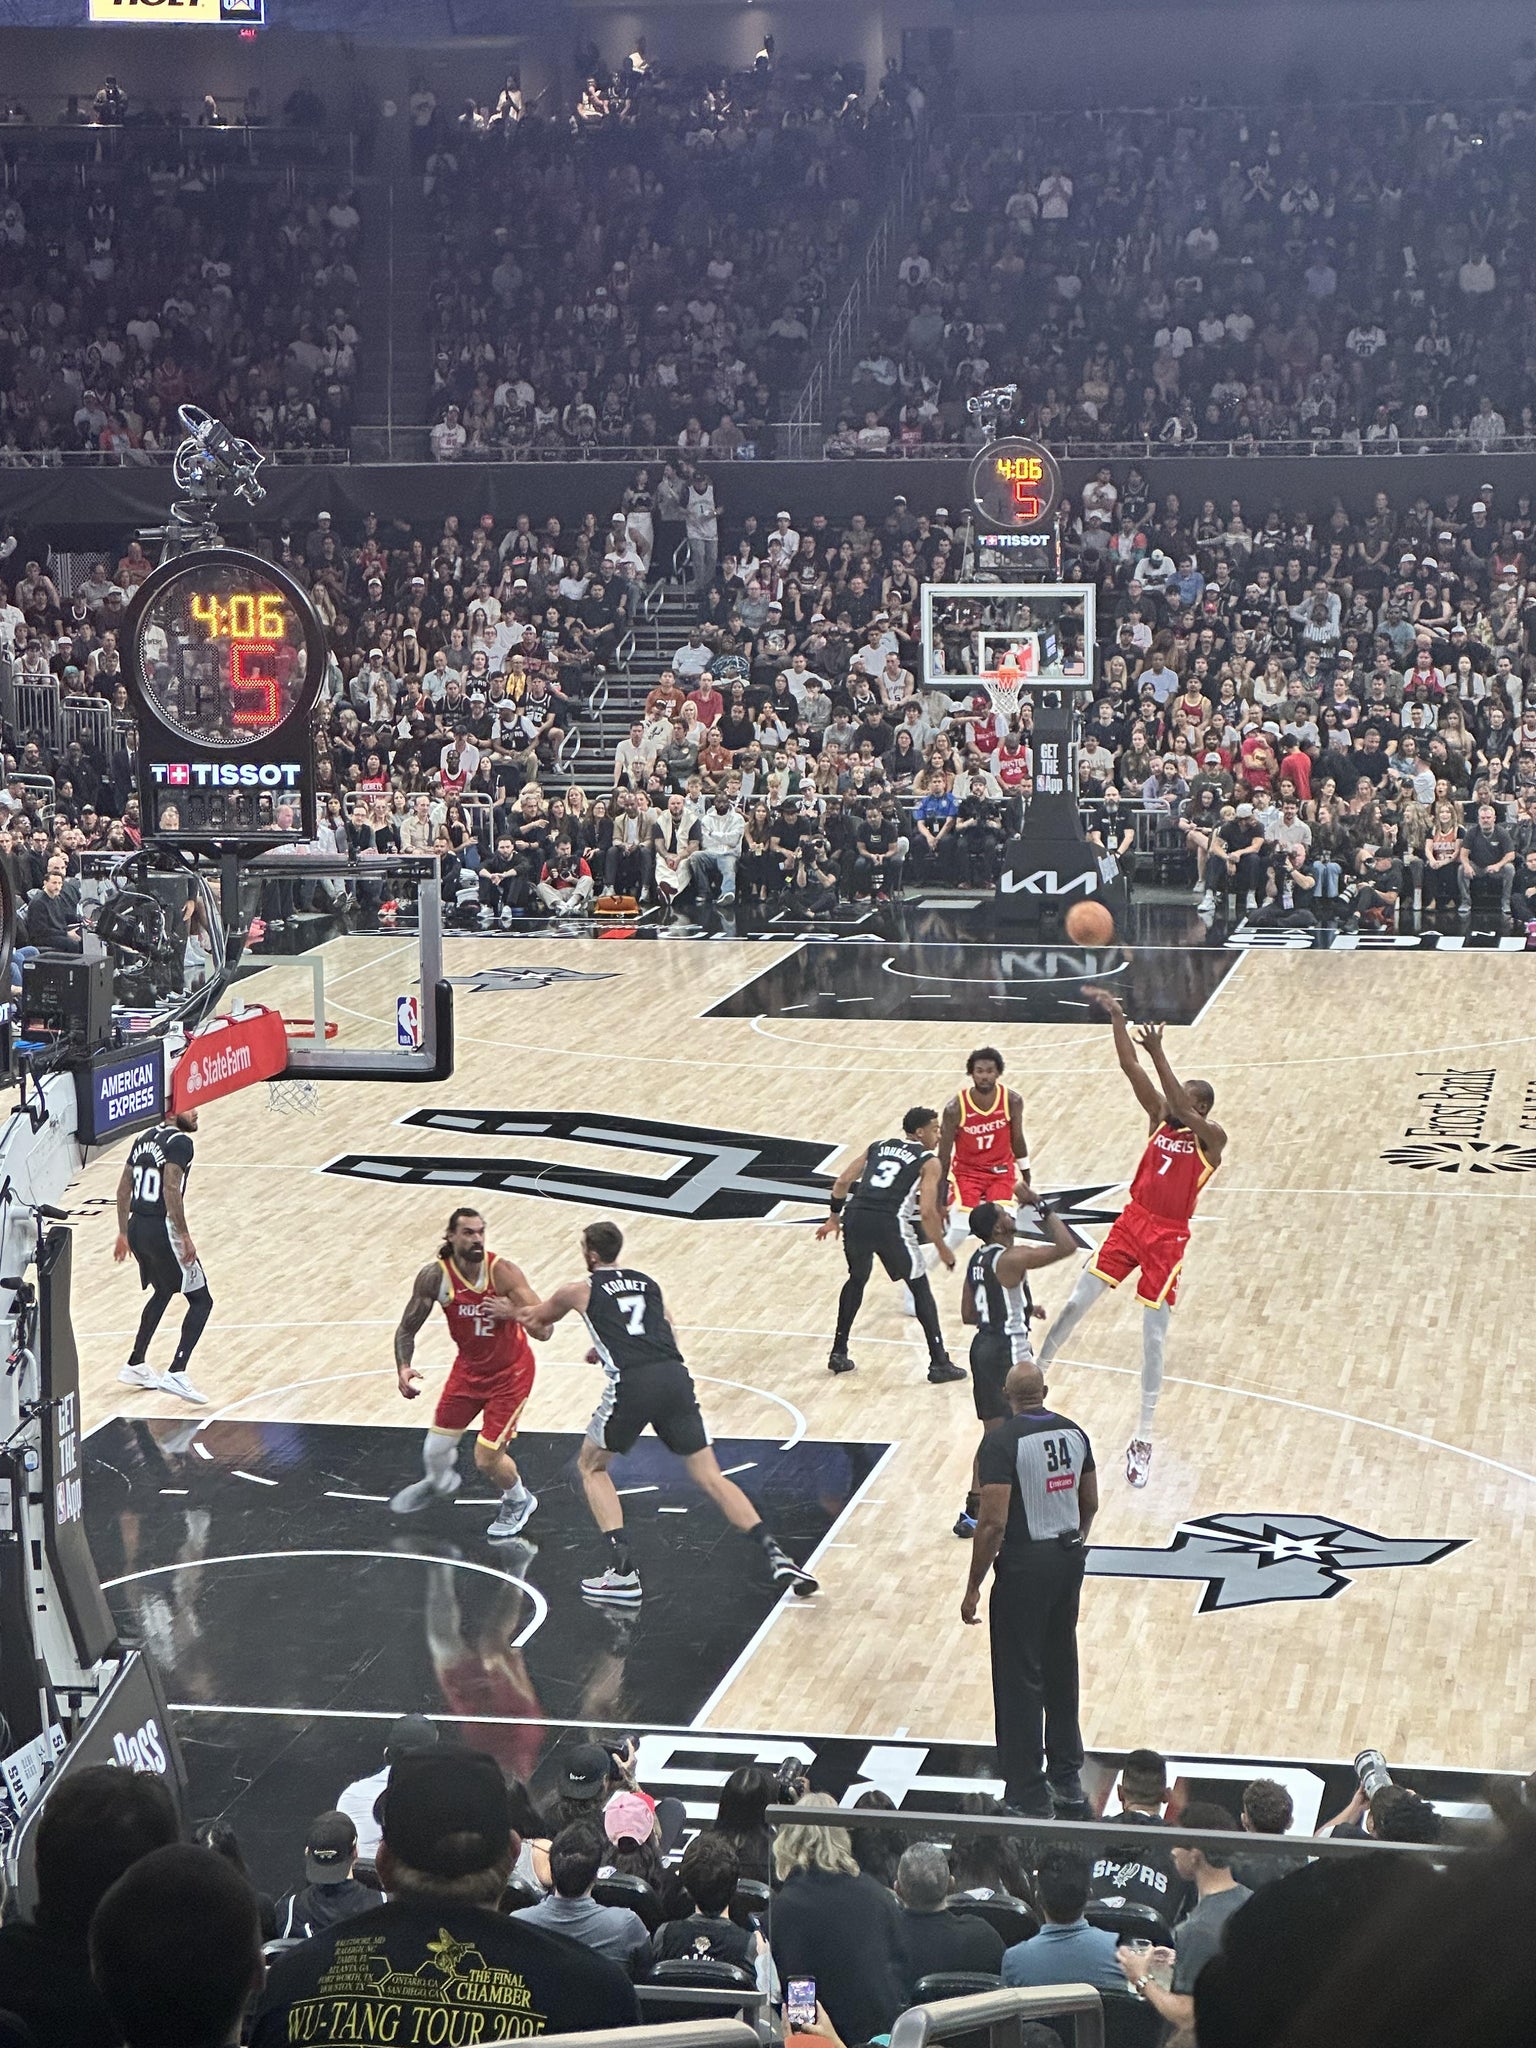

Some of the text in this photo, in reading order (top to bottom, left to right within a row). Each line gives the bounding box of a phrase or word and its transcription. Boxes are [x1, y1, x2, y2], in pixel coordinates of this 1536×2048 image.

[997, 457, 1043, 480] 4:06
[1016, 480, 1038, 518] 5
[998, 534, 1050, 546] TISSOT
[191, 592, 285, 639] 4:06
[231, 642, 278, 723] 5
[1040, 743, 1058, 759] GET
[192, 763, 301, 785] TISSOT
[1040, 759, 1059, 775] THE
[1045, 776, 1063, 794] App
[101, 1062, 153, 1100] AMERICAN
[108, 1086, 154, 1121] EXPRESS
[1405, 1068, 1497, 1139] Frost Bank
[963, 1118, 1007, 1136] ROCKETS
[976, 1134, 994, 1150] 17
[877, 1145, 917, 1165] JOHNSON
[1158, 1154, 1172, 1176] 7
[132, 1165, 161, 1202] 30
[870, 1160, 901, 1189] 3
[602, 1276, 648, 1296] KORNET
[616, 1295, 647, 1336] 7
[974, 1284, 989, 1324] 4
[472, 1316, 496, 1337] 12
[57, 1391, 75, 1437] GET
[58, 1431, 77, 1477] THE
[1043, 1437, 1072, 1473] 34
[428, 1979, 439, 1988] CA
[469, 1968, 525, 1989] THE FINAL
[387, 1986, 401, 1995] SAN
[428, 1989, 440, 1998] CA
[456, 1982, 531, 2009] CHAMBER
[288, 2001, 402, 2043] WU-TANG
[412, 2005, 485, 2047] TOUR
